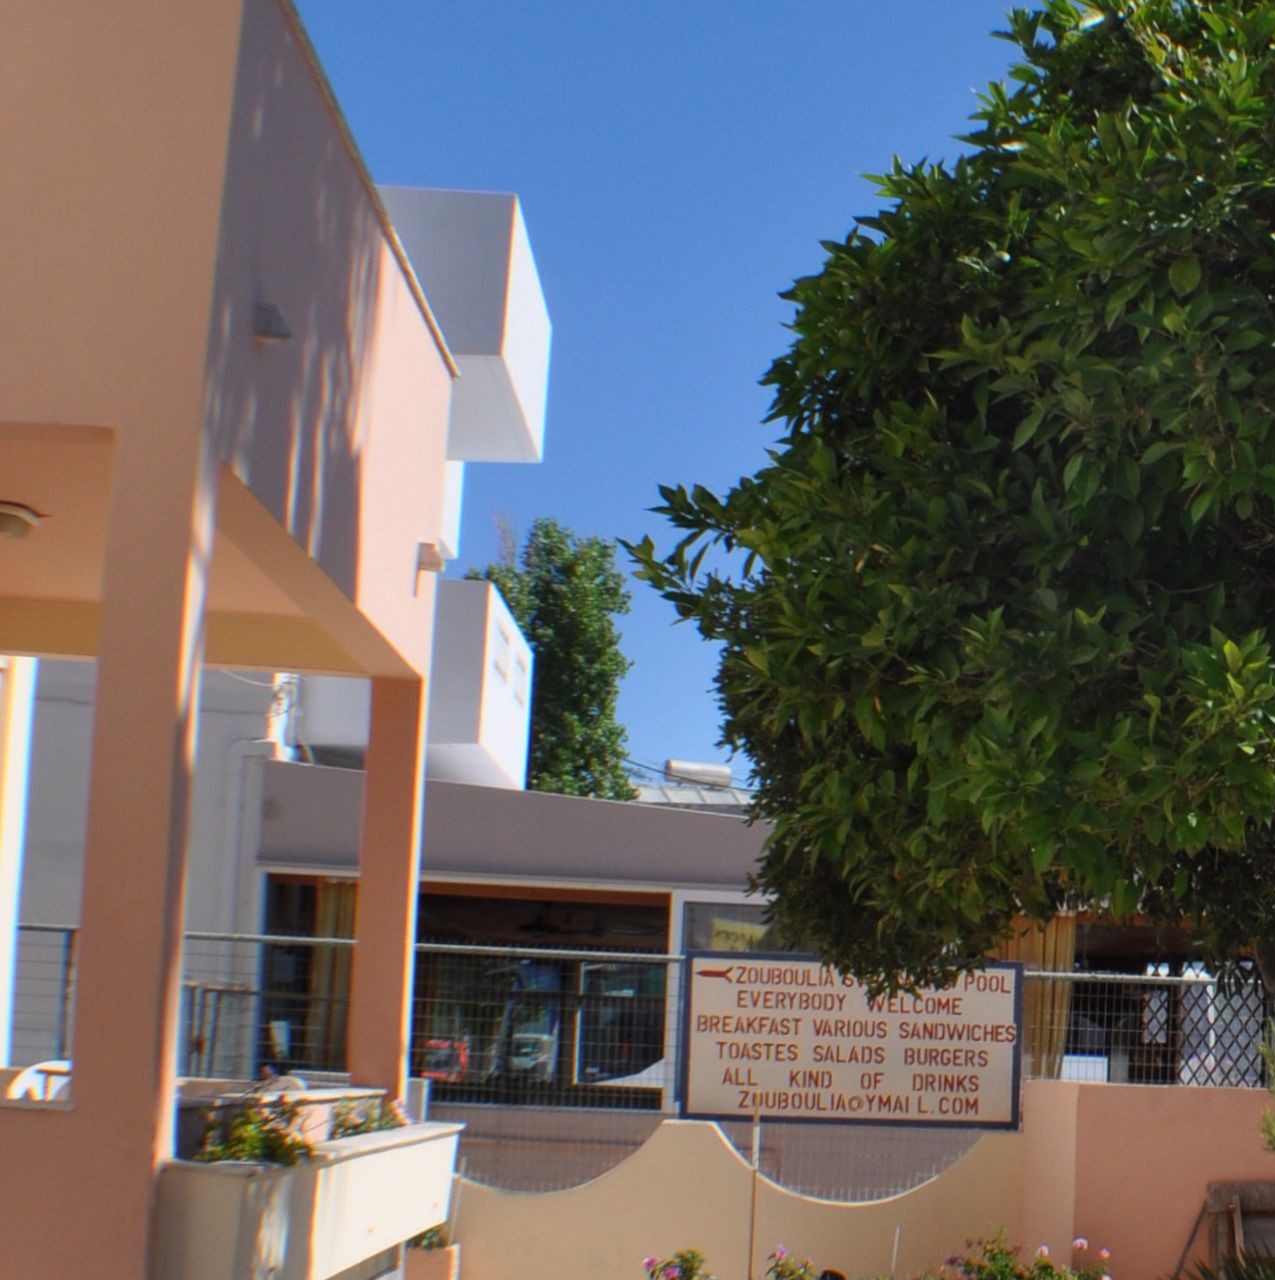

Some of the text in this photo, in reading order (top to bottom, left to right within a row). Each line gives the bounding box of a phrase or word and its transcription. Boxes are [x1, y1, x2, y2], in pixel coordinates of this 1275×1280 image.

[735, 965, 835, 988] ZOUBOULIA
[964, 973, 1011, 994] POOL
[737, 990, 963, 1015] EVERYBODY WELCOME
[697, 1015, 1017, 1044] BREAKFAST VARIOUS SANDWICHES
[716, 1041, 990, 1068] TOASTES SALADS BURGERS
[721, 1067, 980, 1093] ALL KIND OF DRINKS
